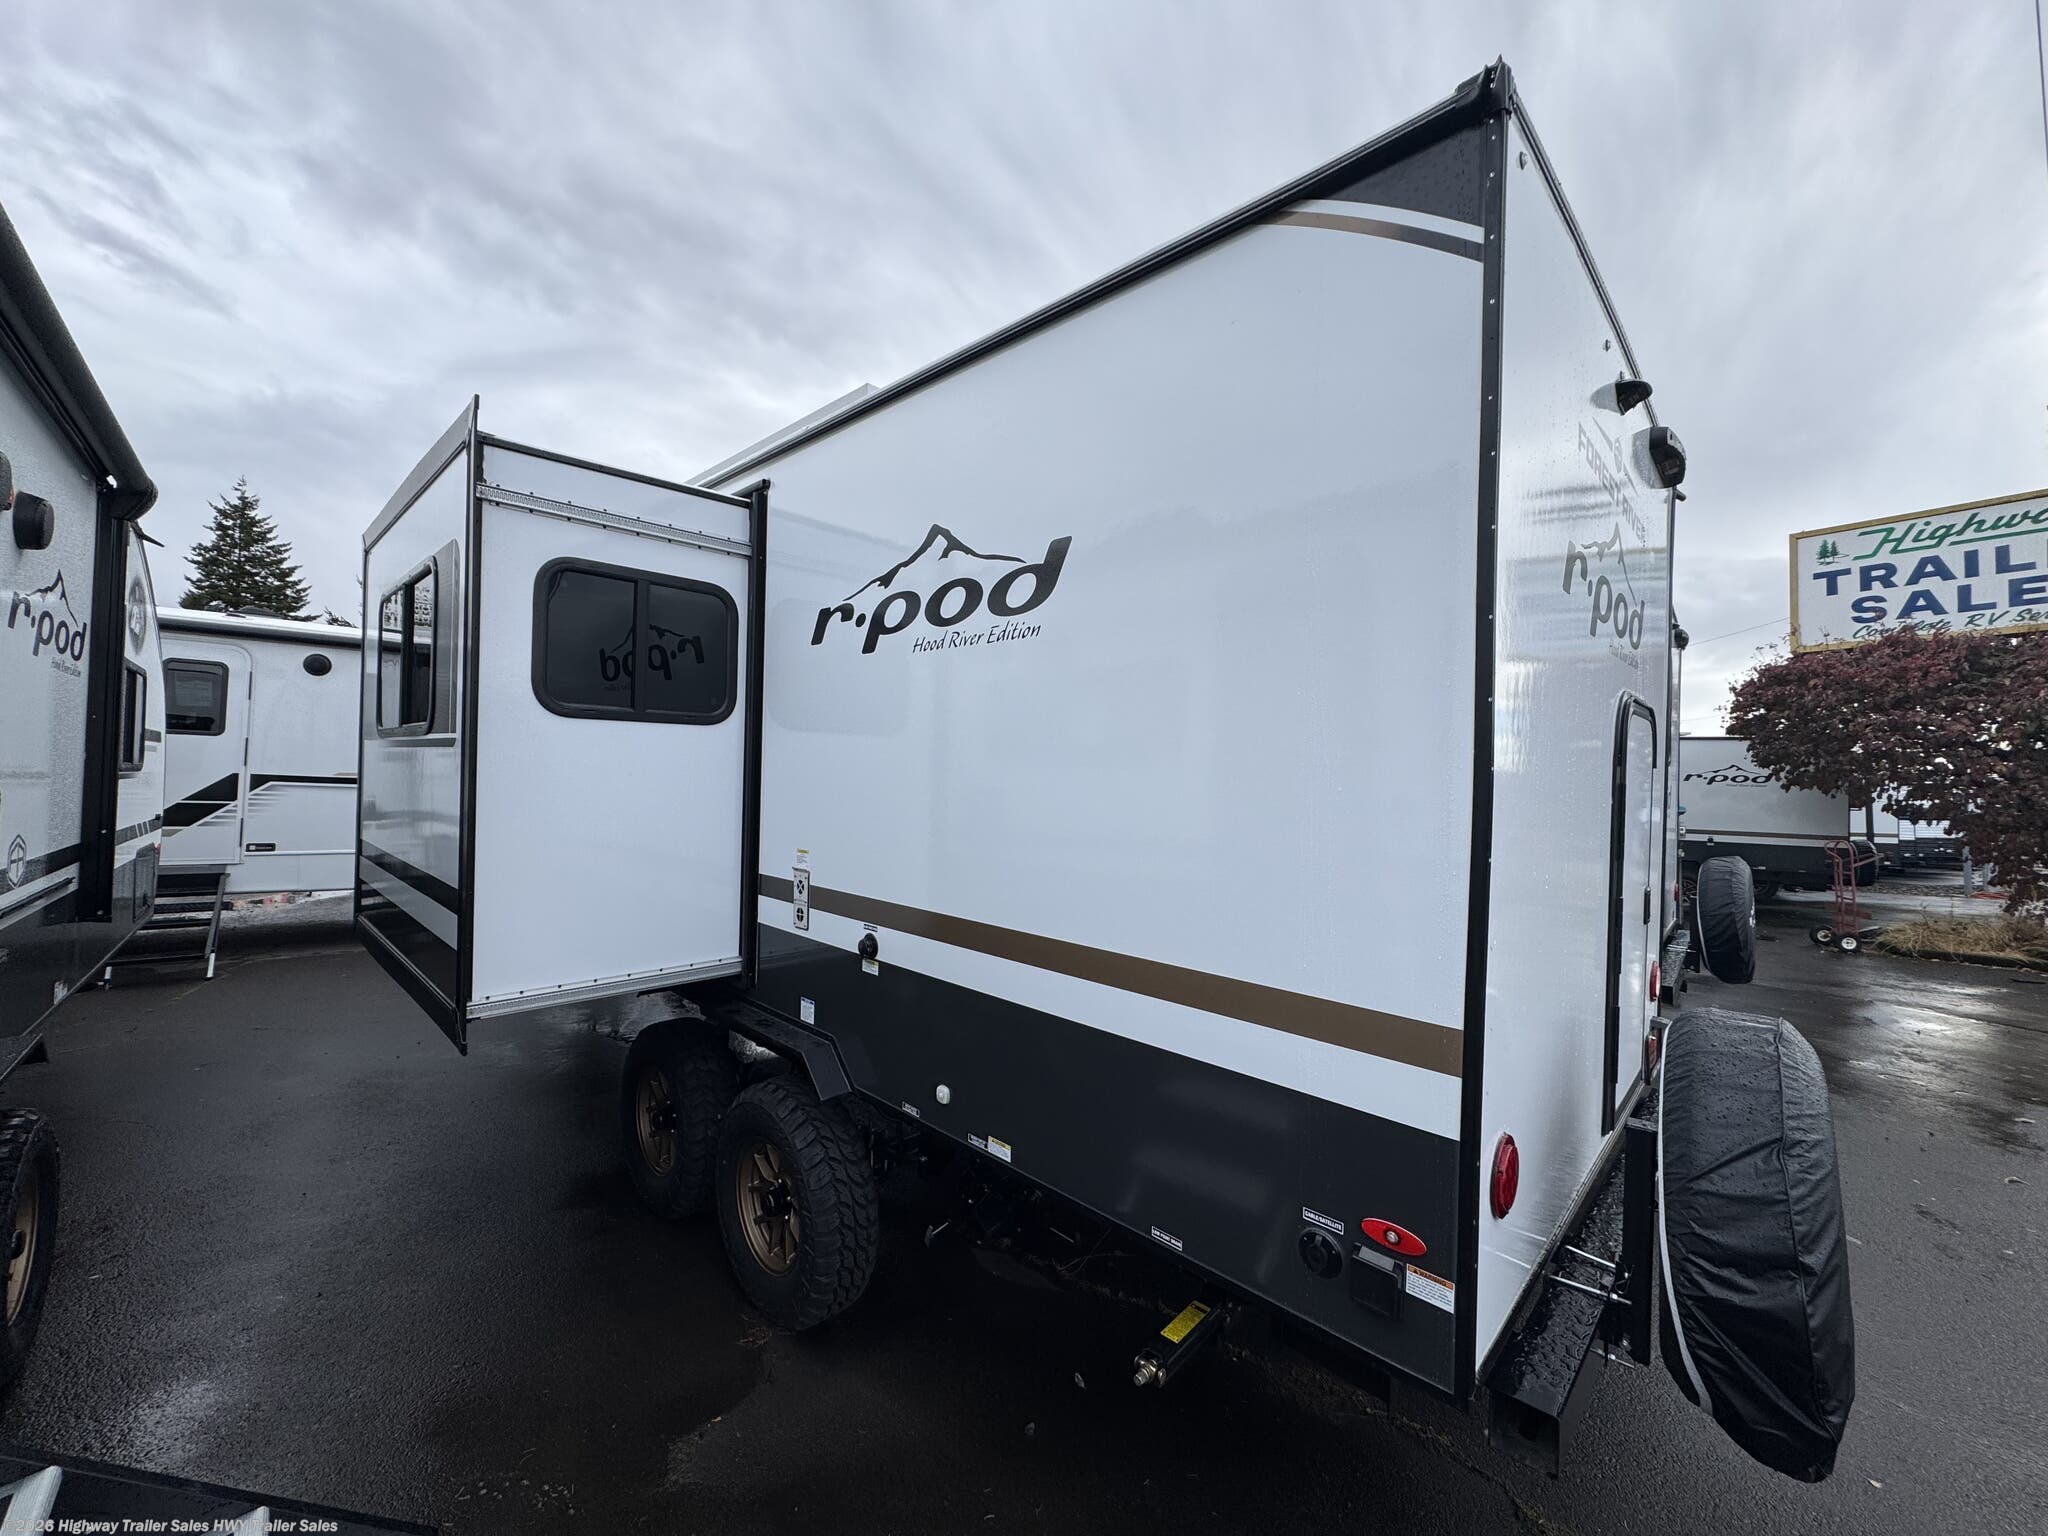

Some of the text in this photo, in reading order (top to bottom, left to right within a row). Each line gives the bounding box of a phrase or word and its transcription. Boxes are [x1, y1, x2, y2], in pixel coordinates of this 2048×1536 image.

[1812, 538, 2048, 597] TRAIL
[912, 620, 1041, 653] Hood River Edition
[1852, 618, 1952, 640] Comlete
[1964, 609, 2010, 628] RV
